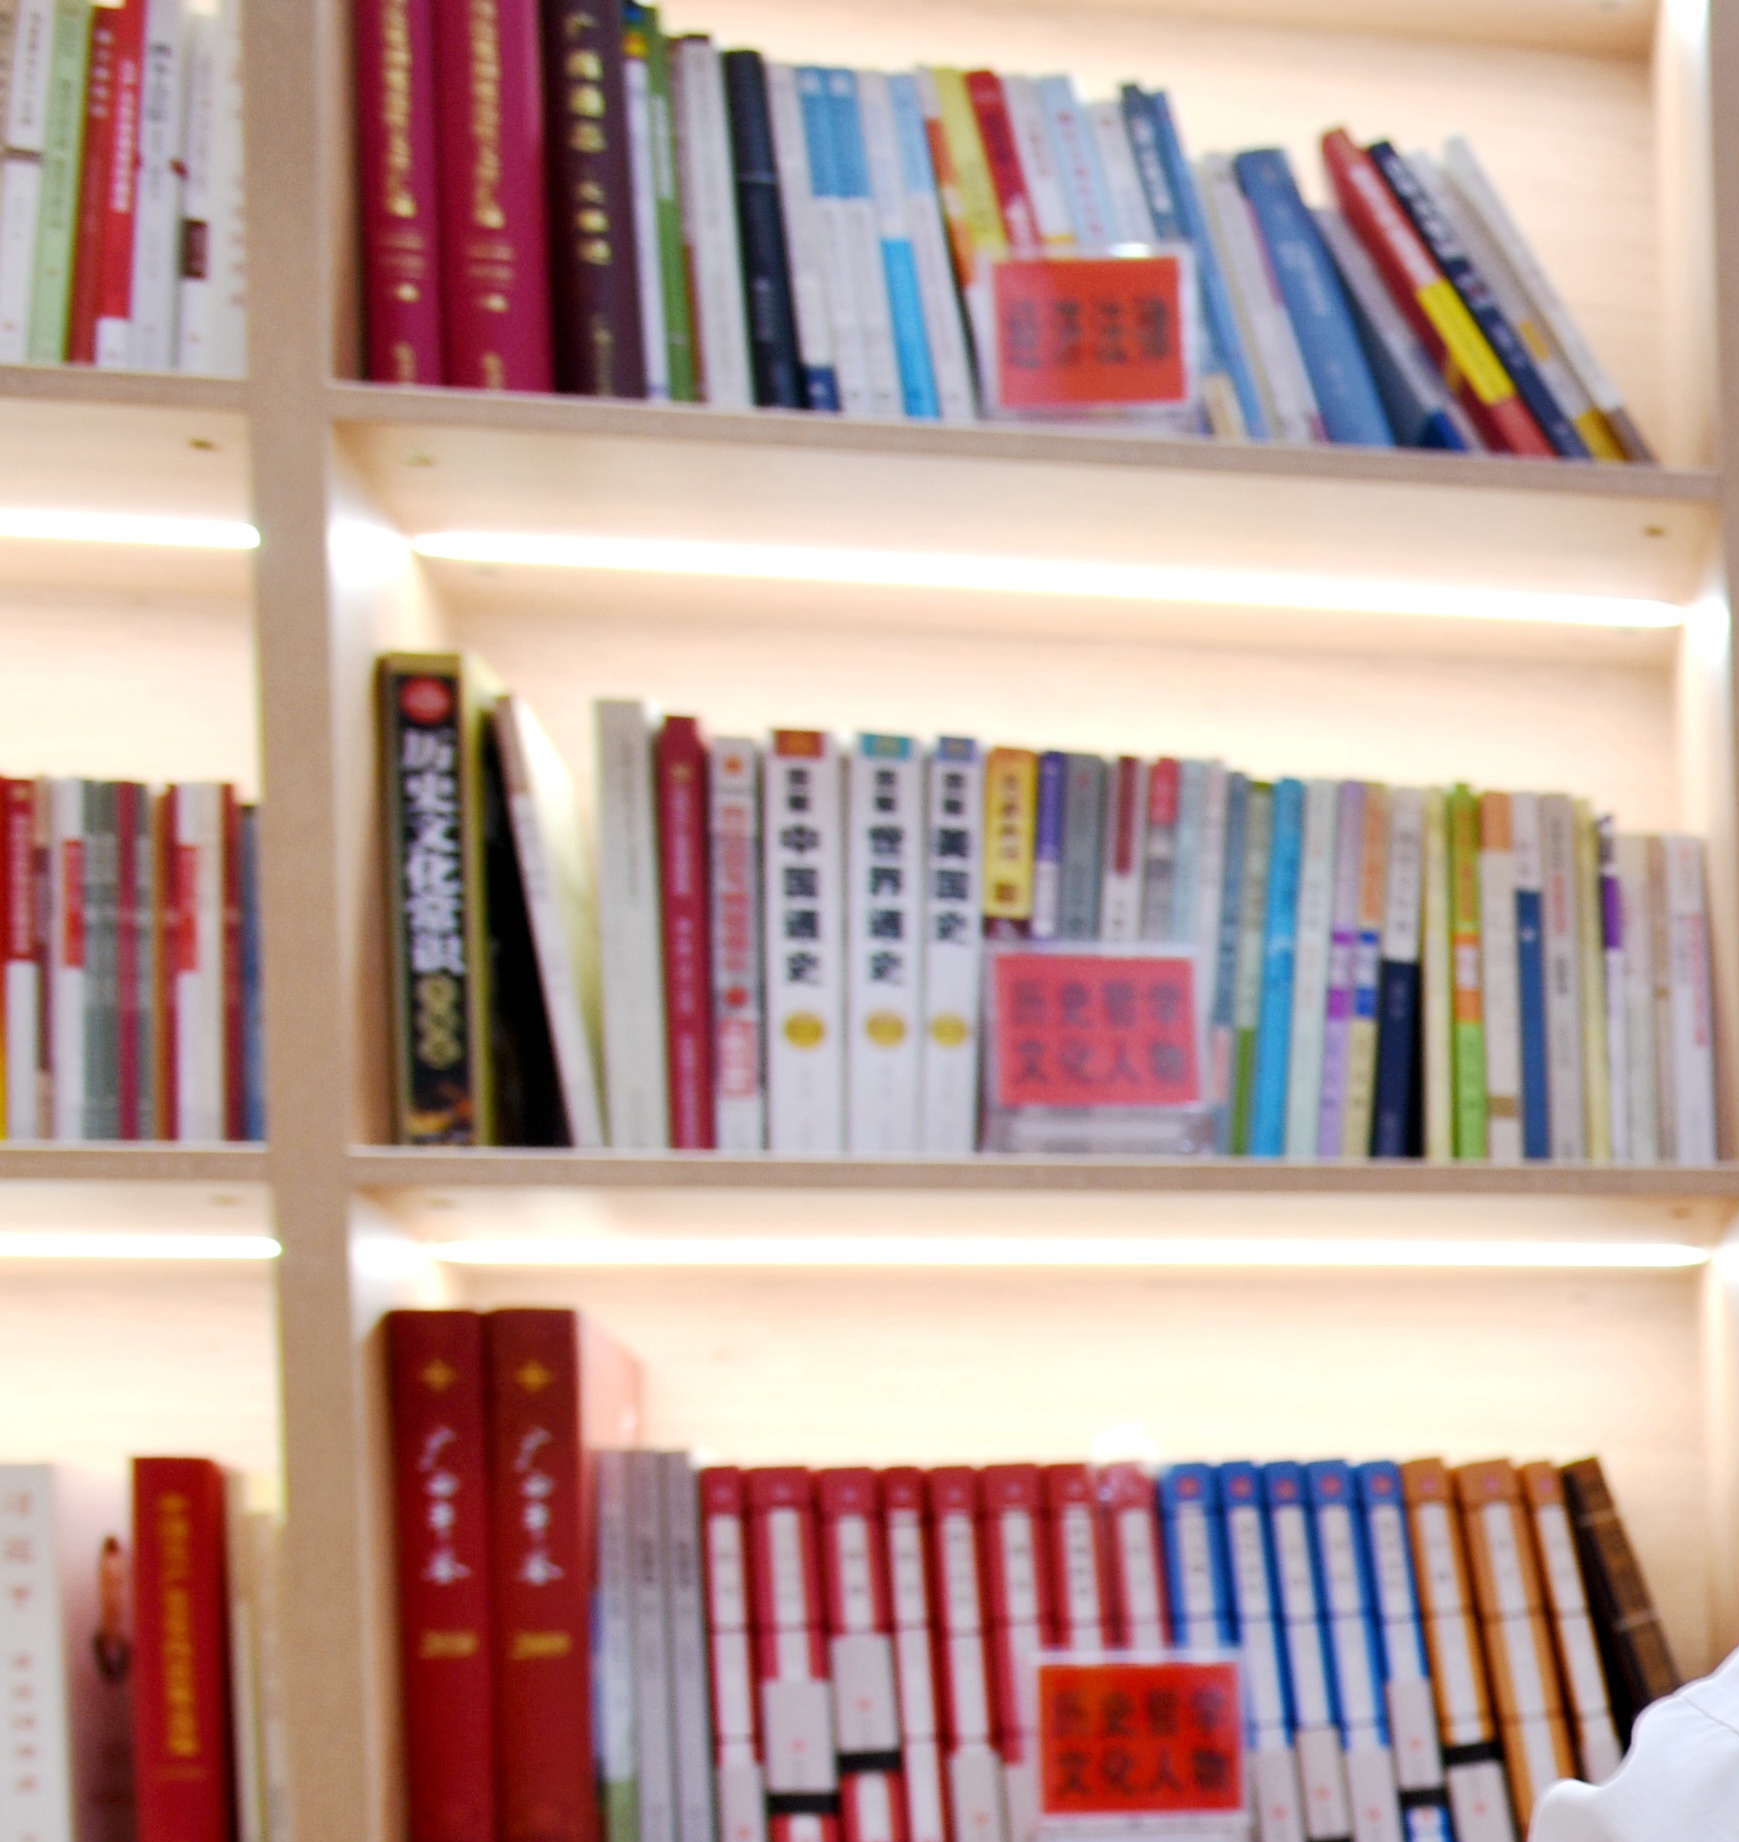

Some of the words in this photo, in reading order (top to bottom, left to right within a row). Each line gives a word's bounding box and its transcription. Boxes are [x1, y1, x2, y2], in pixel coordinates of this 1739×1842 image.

[1016, 1037, 1186, 1086] 文化人物
[1055, 1746, 1230, 1797] 文化人物
